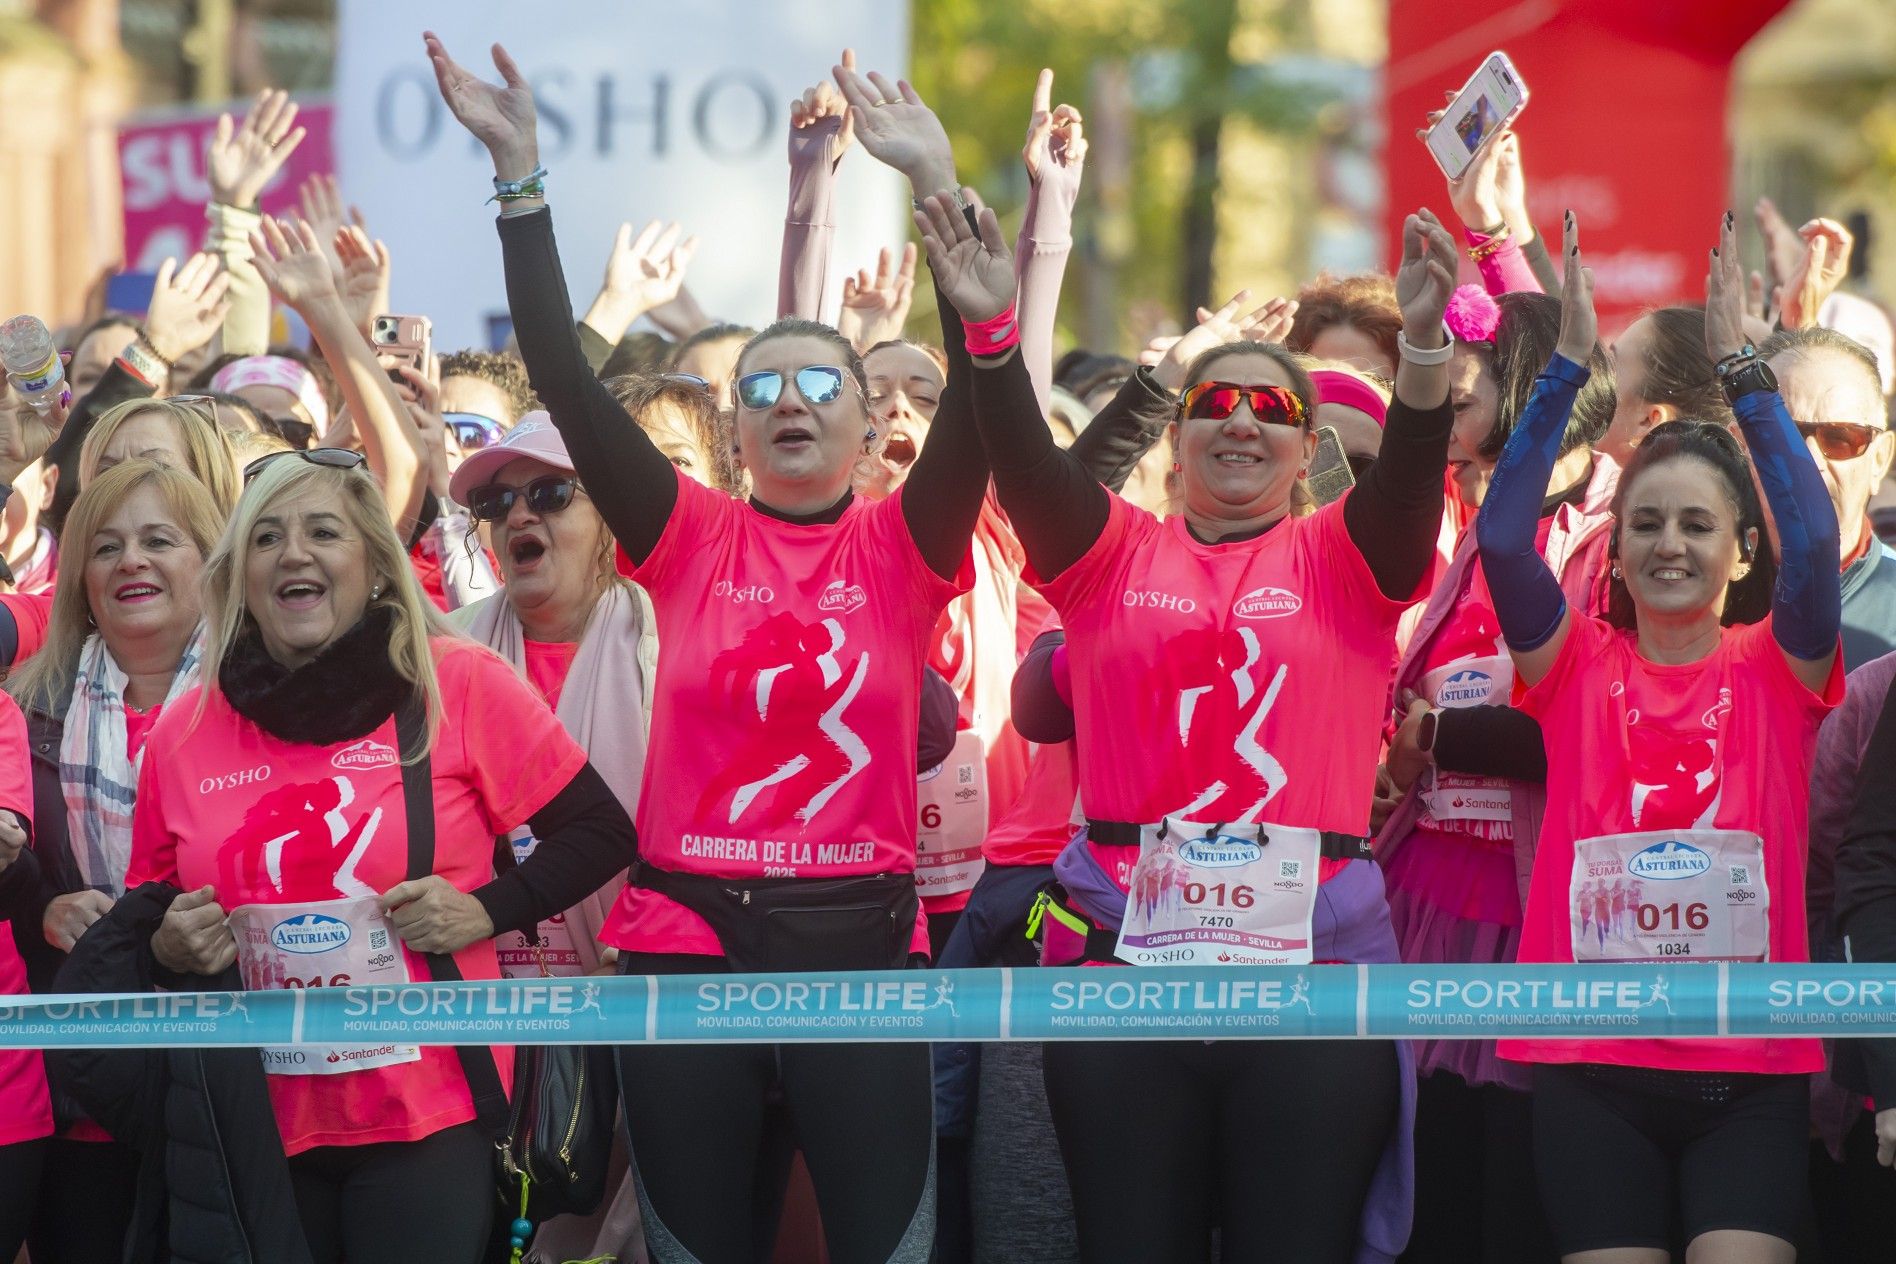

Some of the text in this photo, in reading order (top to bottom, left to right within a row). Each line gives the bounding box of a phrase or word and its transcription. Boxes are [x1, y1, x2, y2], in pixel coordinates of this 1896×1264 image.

[375, 66, 778, 162] OSHO
[715, 580, 775, 604] OYSHO
[1122, 590, 1196, 614] OYSHO
[1238, 600, 1297, 614] ASTURIANA
[336, 753, 395, 767] ASTURIANA
[199, 765, 271, 793] OYSHO
[681, 834, 875, 865] CARRERA DE LA MUJER
[1185, 845, 1256, 862] ASTURIANA
[941, 852, 966, 864] SEVILLA
[1634, 857, 1706, 872] ASTURIANA
[927, 872, 969, 886] Santander
[1588, 866, 1623, 877] SUMA
[1183, 882, 1255, 909] 016
[1199, 916, 1234, 928] 7470
[1637, 902, 1709, 931] 016
[276, 929, 346, 945] ASTURIANA
[1146, 931, 1283, 949] CARRERA DE LA MUJER SEVILLA
[1137, 949, 1194, 964] OYSHO
[1656, 943, 1691, 955] 1034
[505, 954, 515, 962] DE
[517, 954, 527, 962] LA
[530, 954, 558, 962] MJER
[1232, 953, 1290, 965] Santander
[344, 1018, 570, 1032] MOVILIDAD, COMUNICACIÓN Y EVENTOS
[697, 1013, 924, 1028] MOVILIDAD, COMUNICACIÓN Y EVENTOS
[1051, 1013, 1280, 1028] MOVILIDAD, COMUNICACIÓN Y EVENTOS
[1408, 1012, 1639, 1026] MOVILIDAD, COMUNICACIÓN Y EVENTOS
[1770, 1013, 1839, 1025] MOVILIDAD,
[59, 1021, 151, 1034] COMUNICACIÓN
[153, 1022, 161, 1032] Y
[163, 1022, 217, 1033] EVENTOS
[341, 1045, 396, 1061] Santander
